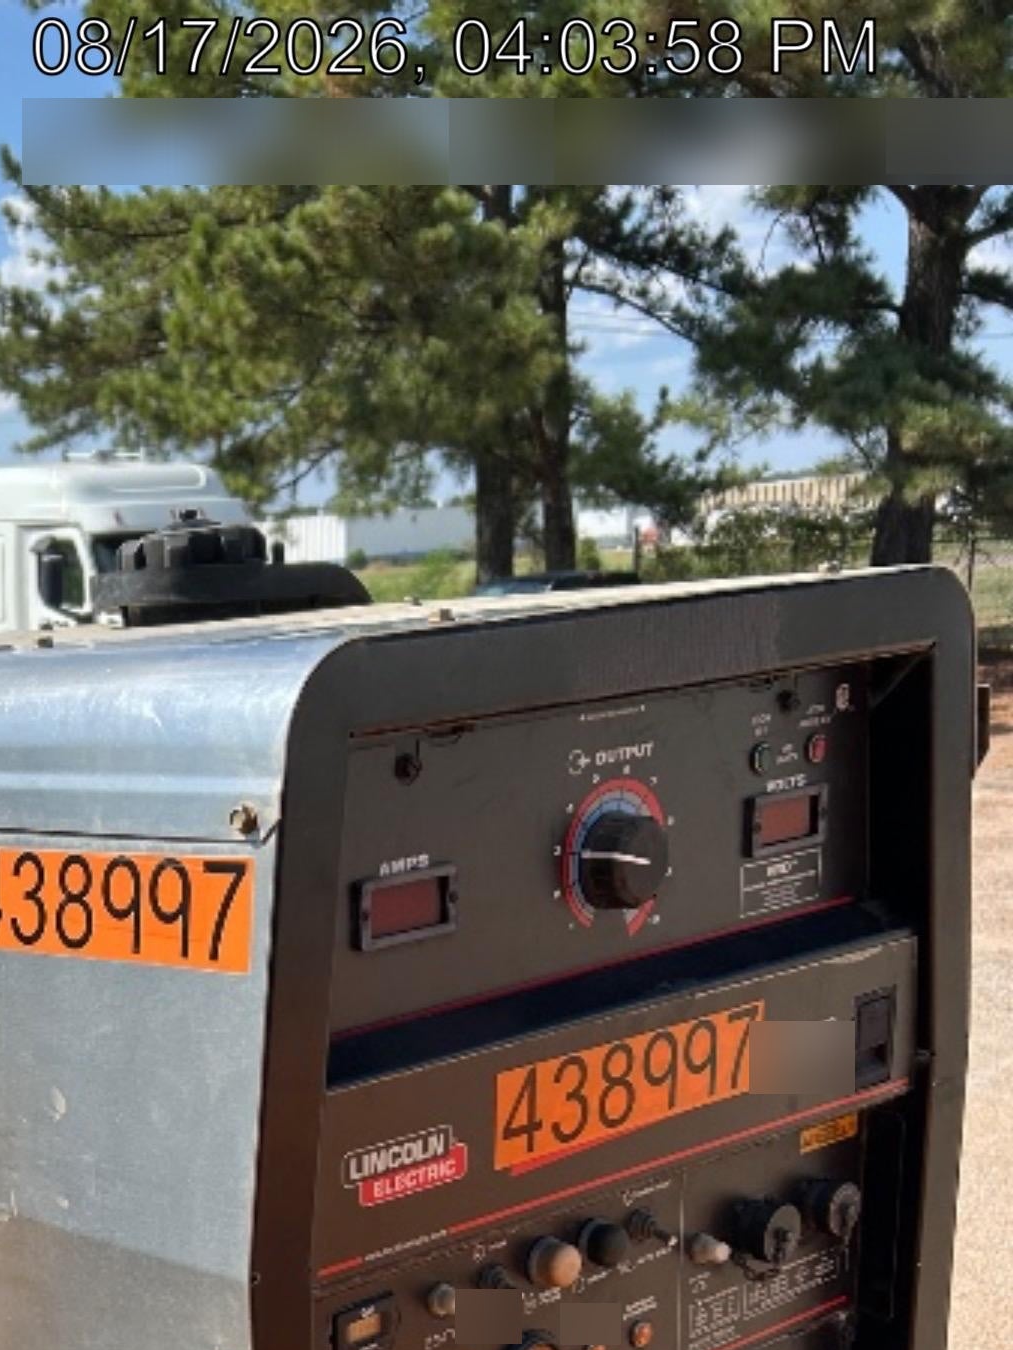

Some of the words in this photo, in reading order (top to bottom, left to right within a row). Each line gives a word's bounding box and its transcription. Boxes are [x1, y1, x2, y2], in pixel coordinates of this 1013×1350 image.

[595, 743, 652, 767] OUTPUT
[379, 853, 429, 877] AMPS
[502, 1004, 760, 1153] 438997
[349, 1132, 444, 1180] LINCOLN
[373, 1159, 457, 1199] ELECTRIC
